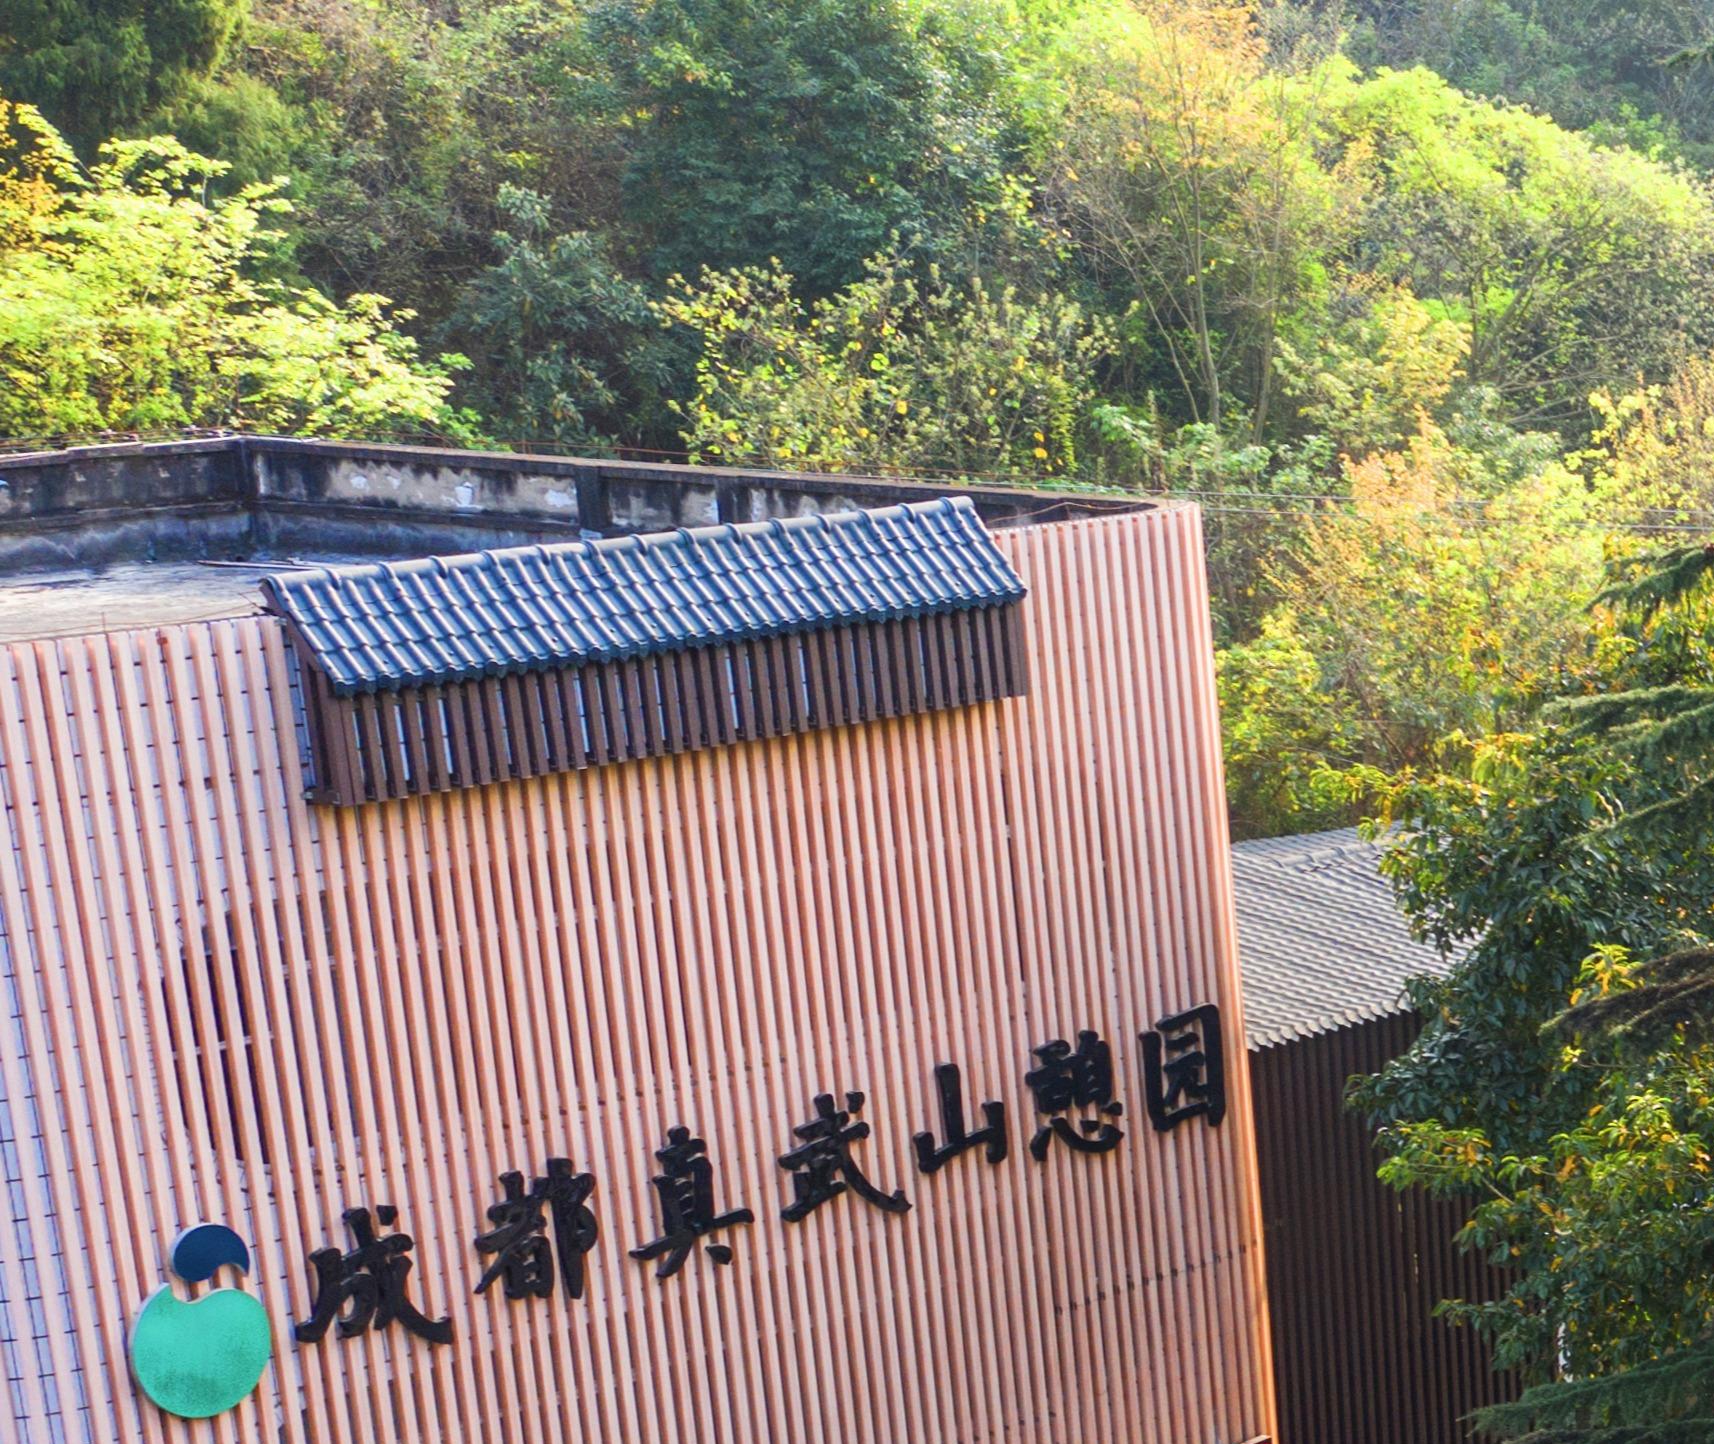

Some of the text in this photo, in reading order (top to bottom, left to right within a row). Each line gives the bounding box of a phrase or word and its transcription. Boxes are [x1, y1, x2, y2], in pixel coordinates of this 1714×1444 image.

[294, 1002, 1226, 1344] 成都真武山憩园
